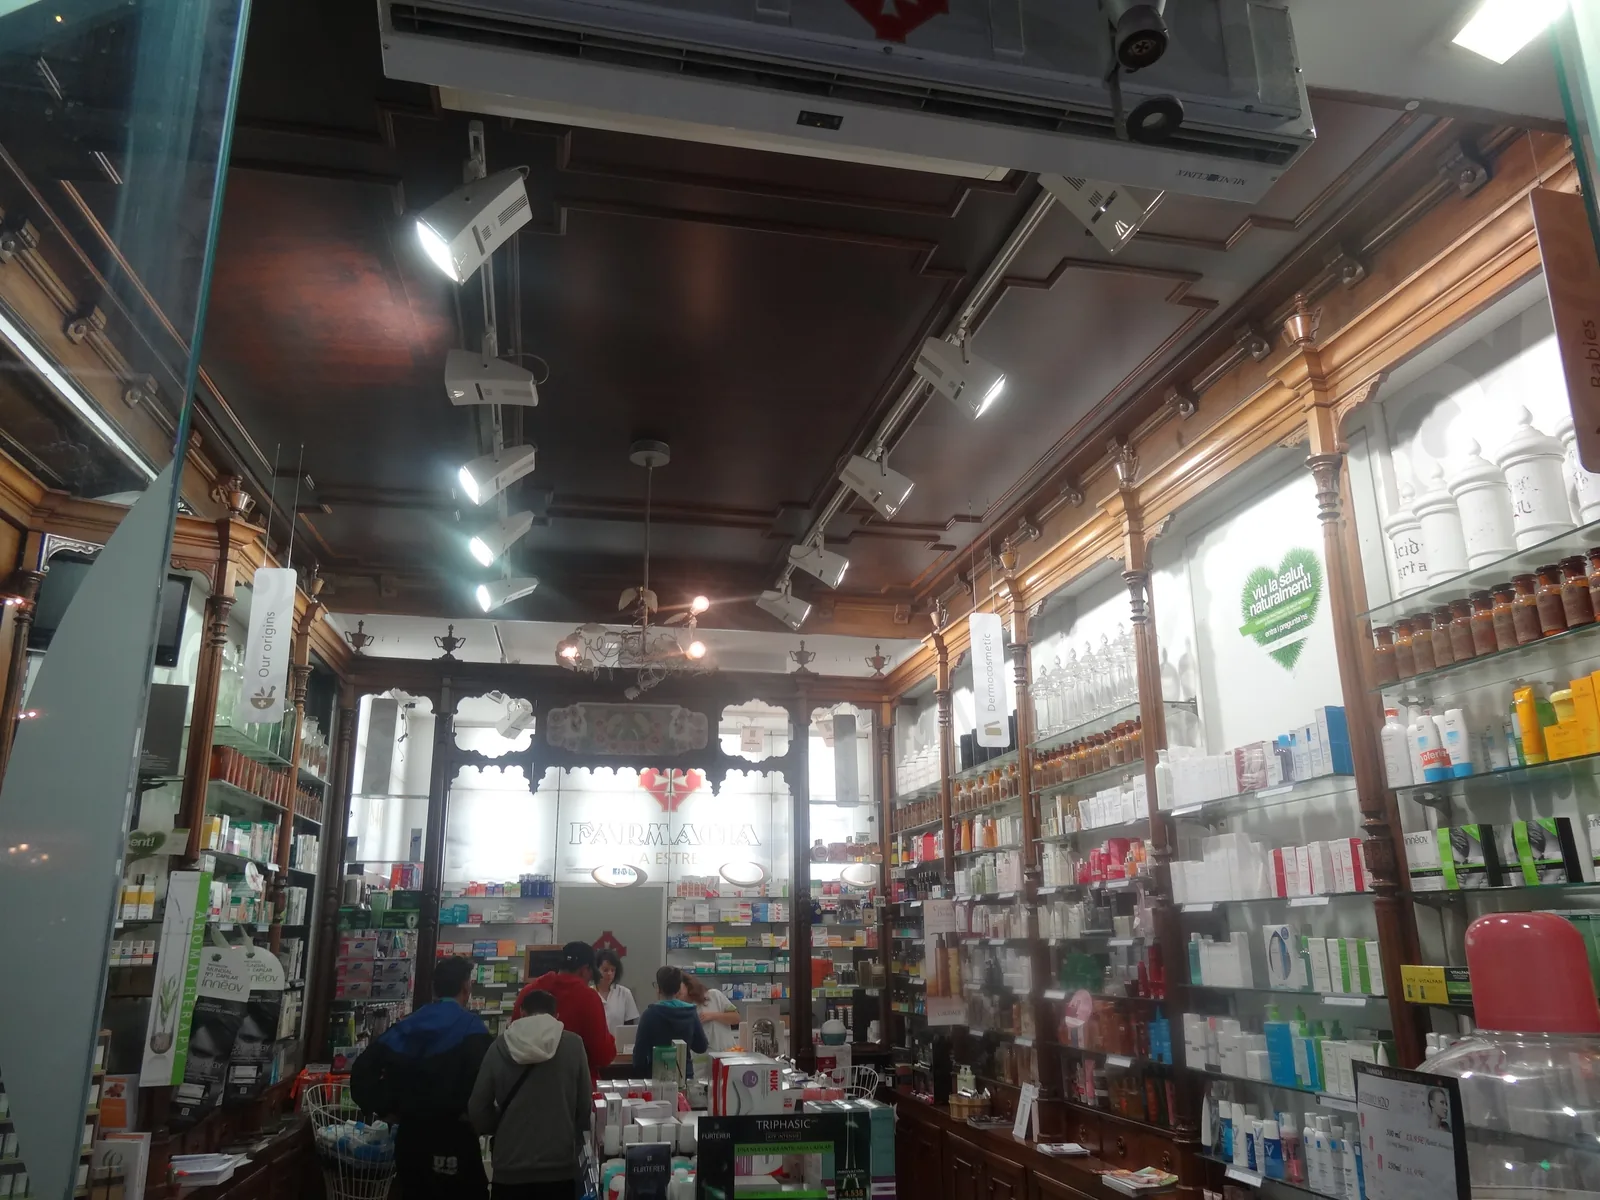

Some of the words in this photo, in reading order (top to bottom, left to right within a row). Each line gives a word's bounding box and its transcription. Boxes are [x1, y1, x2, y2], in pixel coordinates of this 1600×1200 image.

[1249, 572, 1312, 617] naturalment!
[1252, 584, 1268, 601] viu
[1268, 578, 1279, 593] la
[1279, 562, 1305, 587] salut
[262, 611, 277, 651] origins
[258, 655, 271, 677] Our
[982, 633, 996, 712] Dermocosmetic
[569, 822, 761, 846] FARMACIA
[175, 911, 207, 1057] AROMATHERAPY
[770, 1069, 778, 1091] NUK
[756, 1119, 811, 1131] TRIPHASIC
